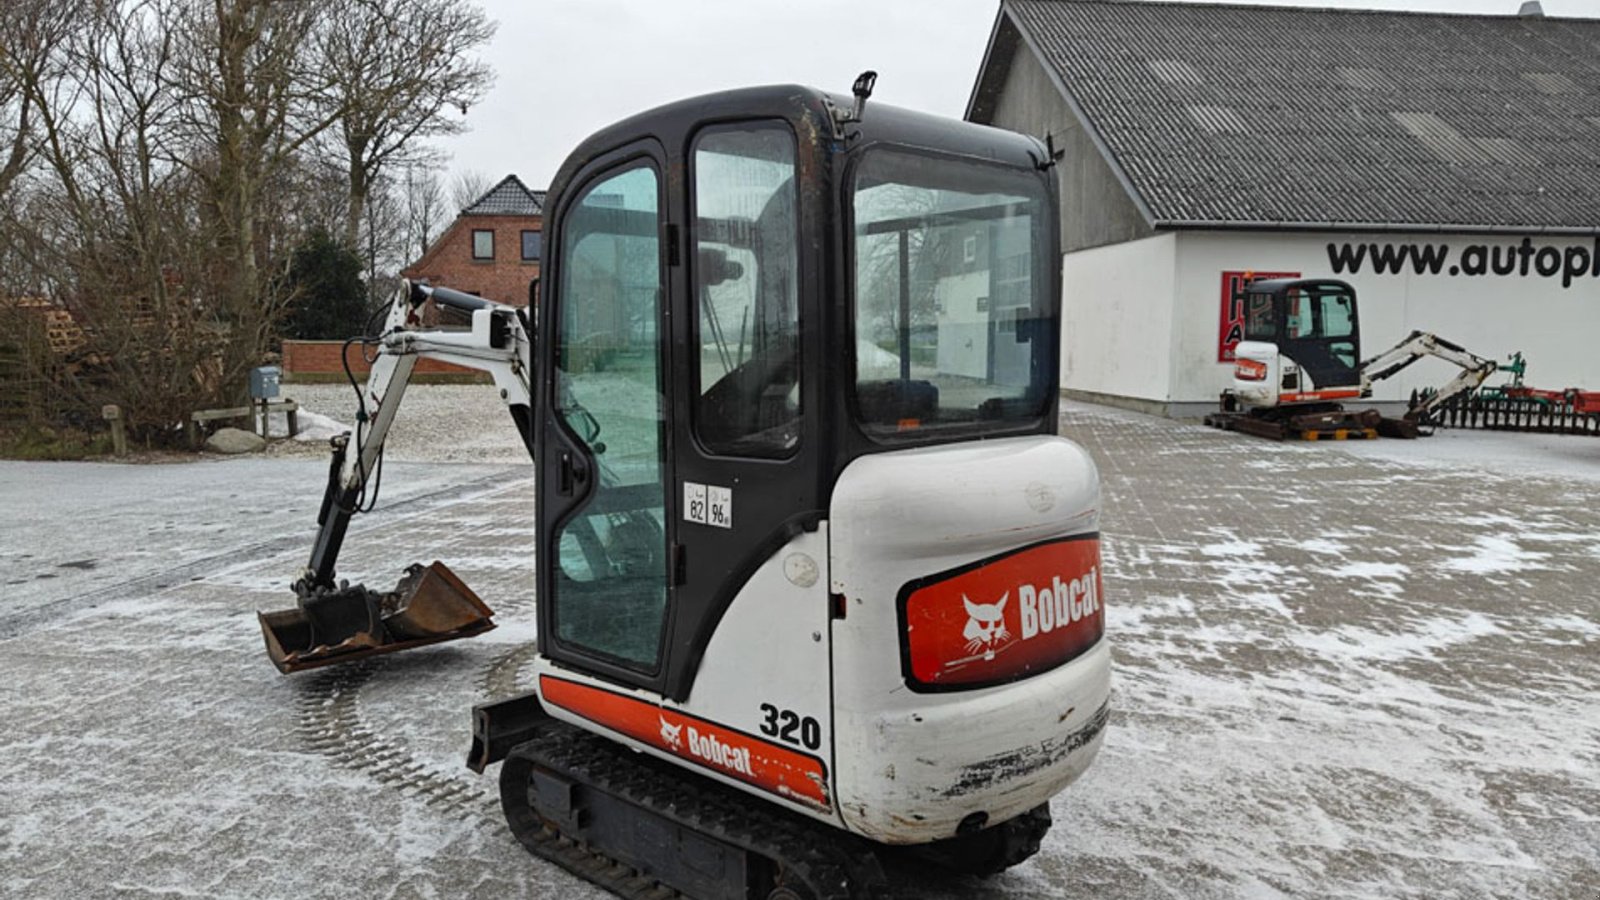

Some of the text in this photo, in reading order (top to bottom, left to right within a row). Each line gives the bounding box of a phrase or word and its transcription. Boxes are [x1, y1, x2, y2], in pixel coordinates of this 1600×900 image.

[690, 500, 704, 521] 82
[1018, 565, 1100, 640] Bobcat
[686, 726, 756, 777] Bobcat
[759, 702, 821, 751] 320
